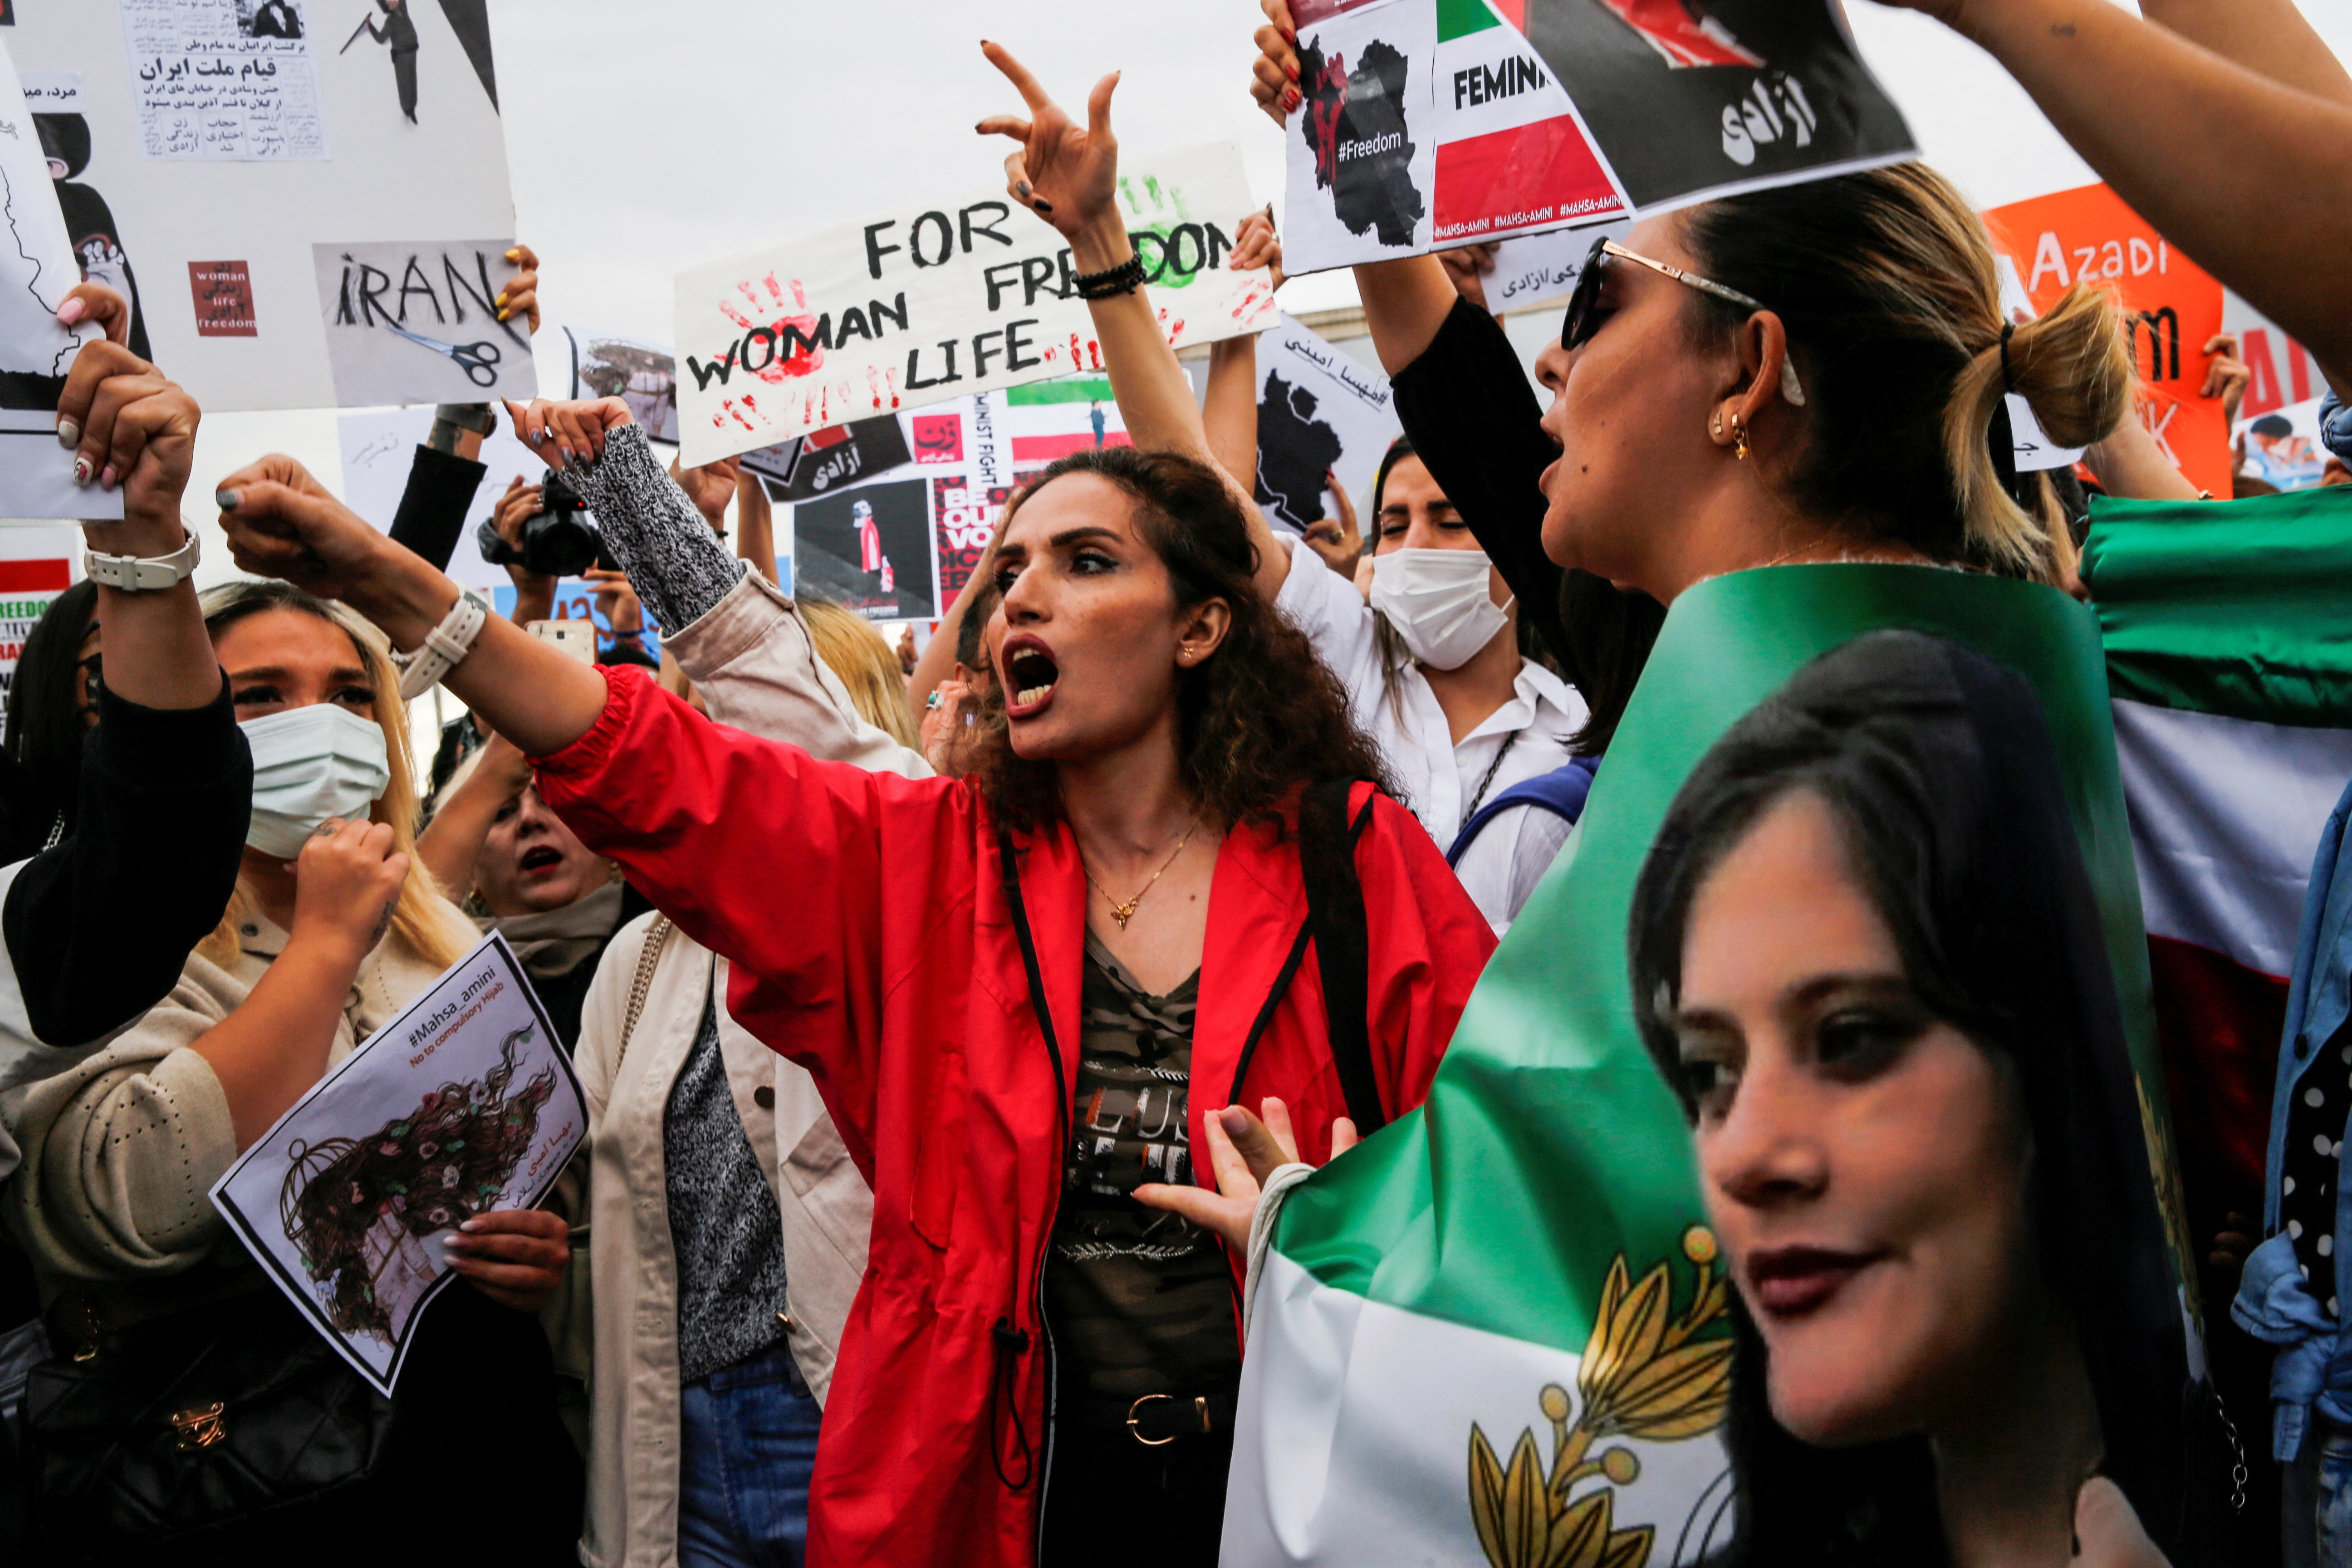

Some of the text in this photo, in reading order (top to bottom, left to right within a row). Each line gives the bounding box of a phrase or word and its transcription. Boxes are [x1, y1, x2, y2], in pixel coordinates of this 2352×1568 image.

[140, 57, 277, 82] قیام ملت ایران
[1723, 70, 1816, 166] آزادی
[1338, 131, 1401, 162] #Freedom
[1435, 194, 1623, 239] #MAHSA-AMINI #MAHSA-AMINI #MAHSA-AMIN
[864, 201, 1014, 279] FOR
[196, 272, 246, 281] woman
[198, 318, 256, 328] freedom
[213, 297, 236, 306] life
[686, 293, 908, 392] WOMAN
[905, 319, 1044, 390] LIFE
[813, 443, 862, 490] آزادی
[978, 444, 997, 484] FIGHT
[409, 965, 496, 1048] #Mahsa_amini
[410, 982, 504, 1069] No to compulsory Hijab
